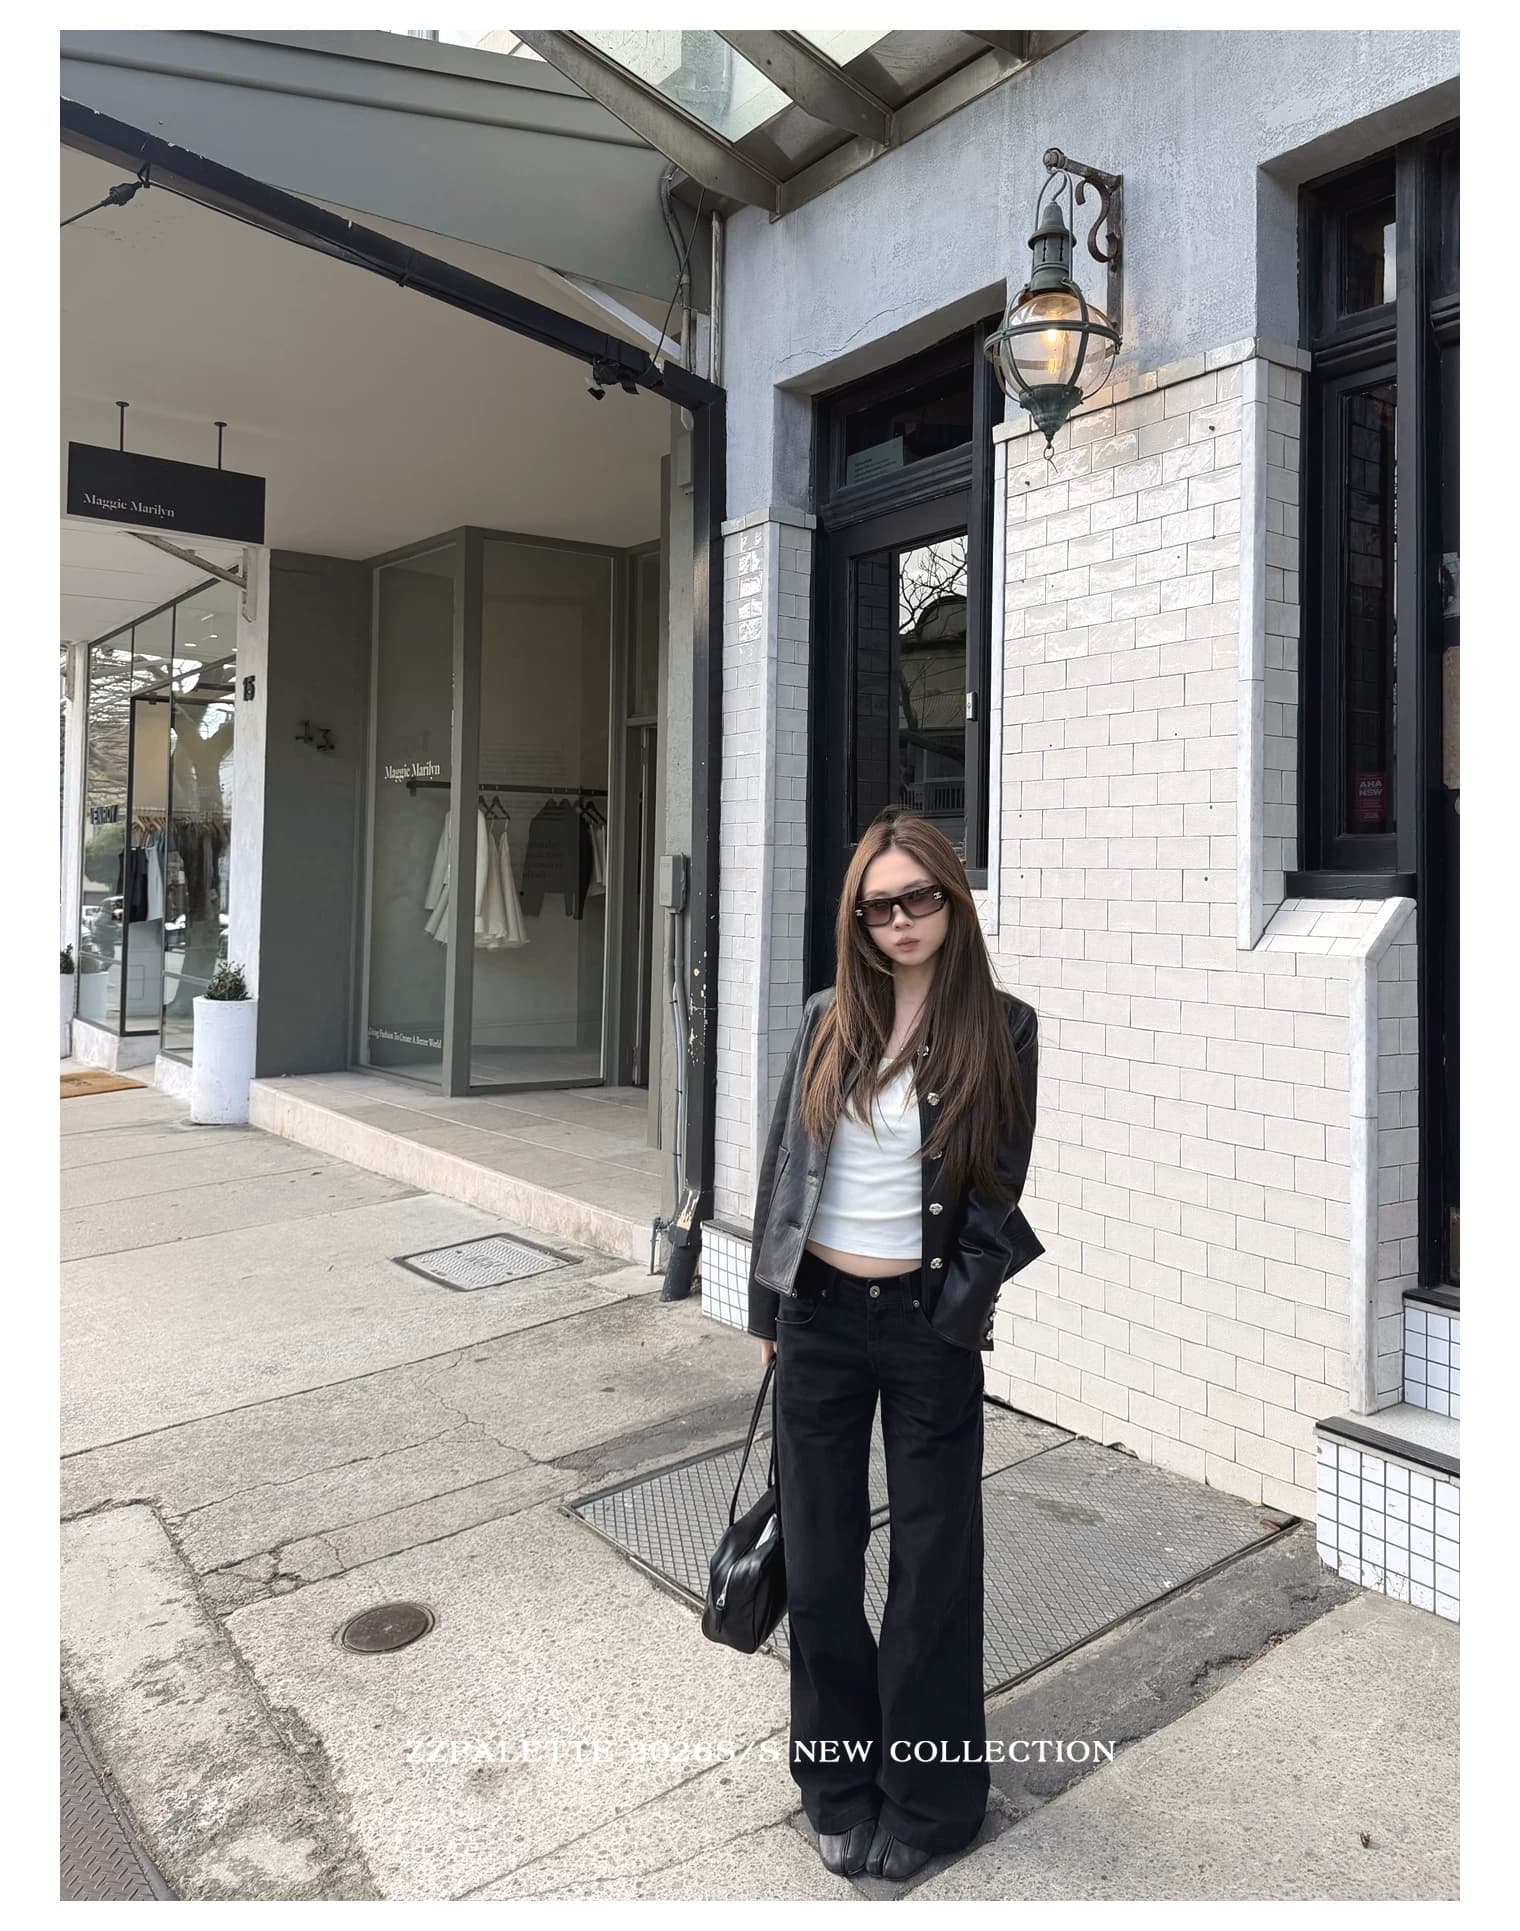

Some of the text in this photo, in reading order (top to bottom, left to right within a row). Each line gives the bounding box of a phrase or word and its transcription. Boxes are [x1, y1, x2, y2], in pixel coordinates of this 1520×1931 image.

[83, 493, 175, 519] Maggie Marilyn
[384, 760, 441, 783] Maggie Marilyn
[1359, 779, 1383, 788] AHA
[1359, 788, 1383, 797] NSW
